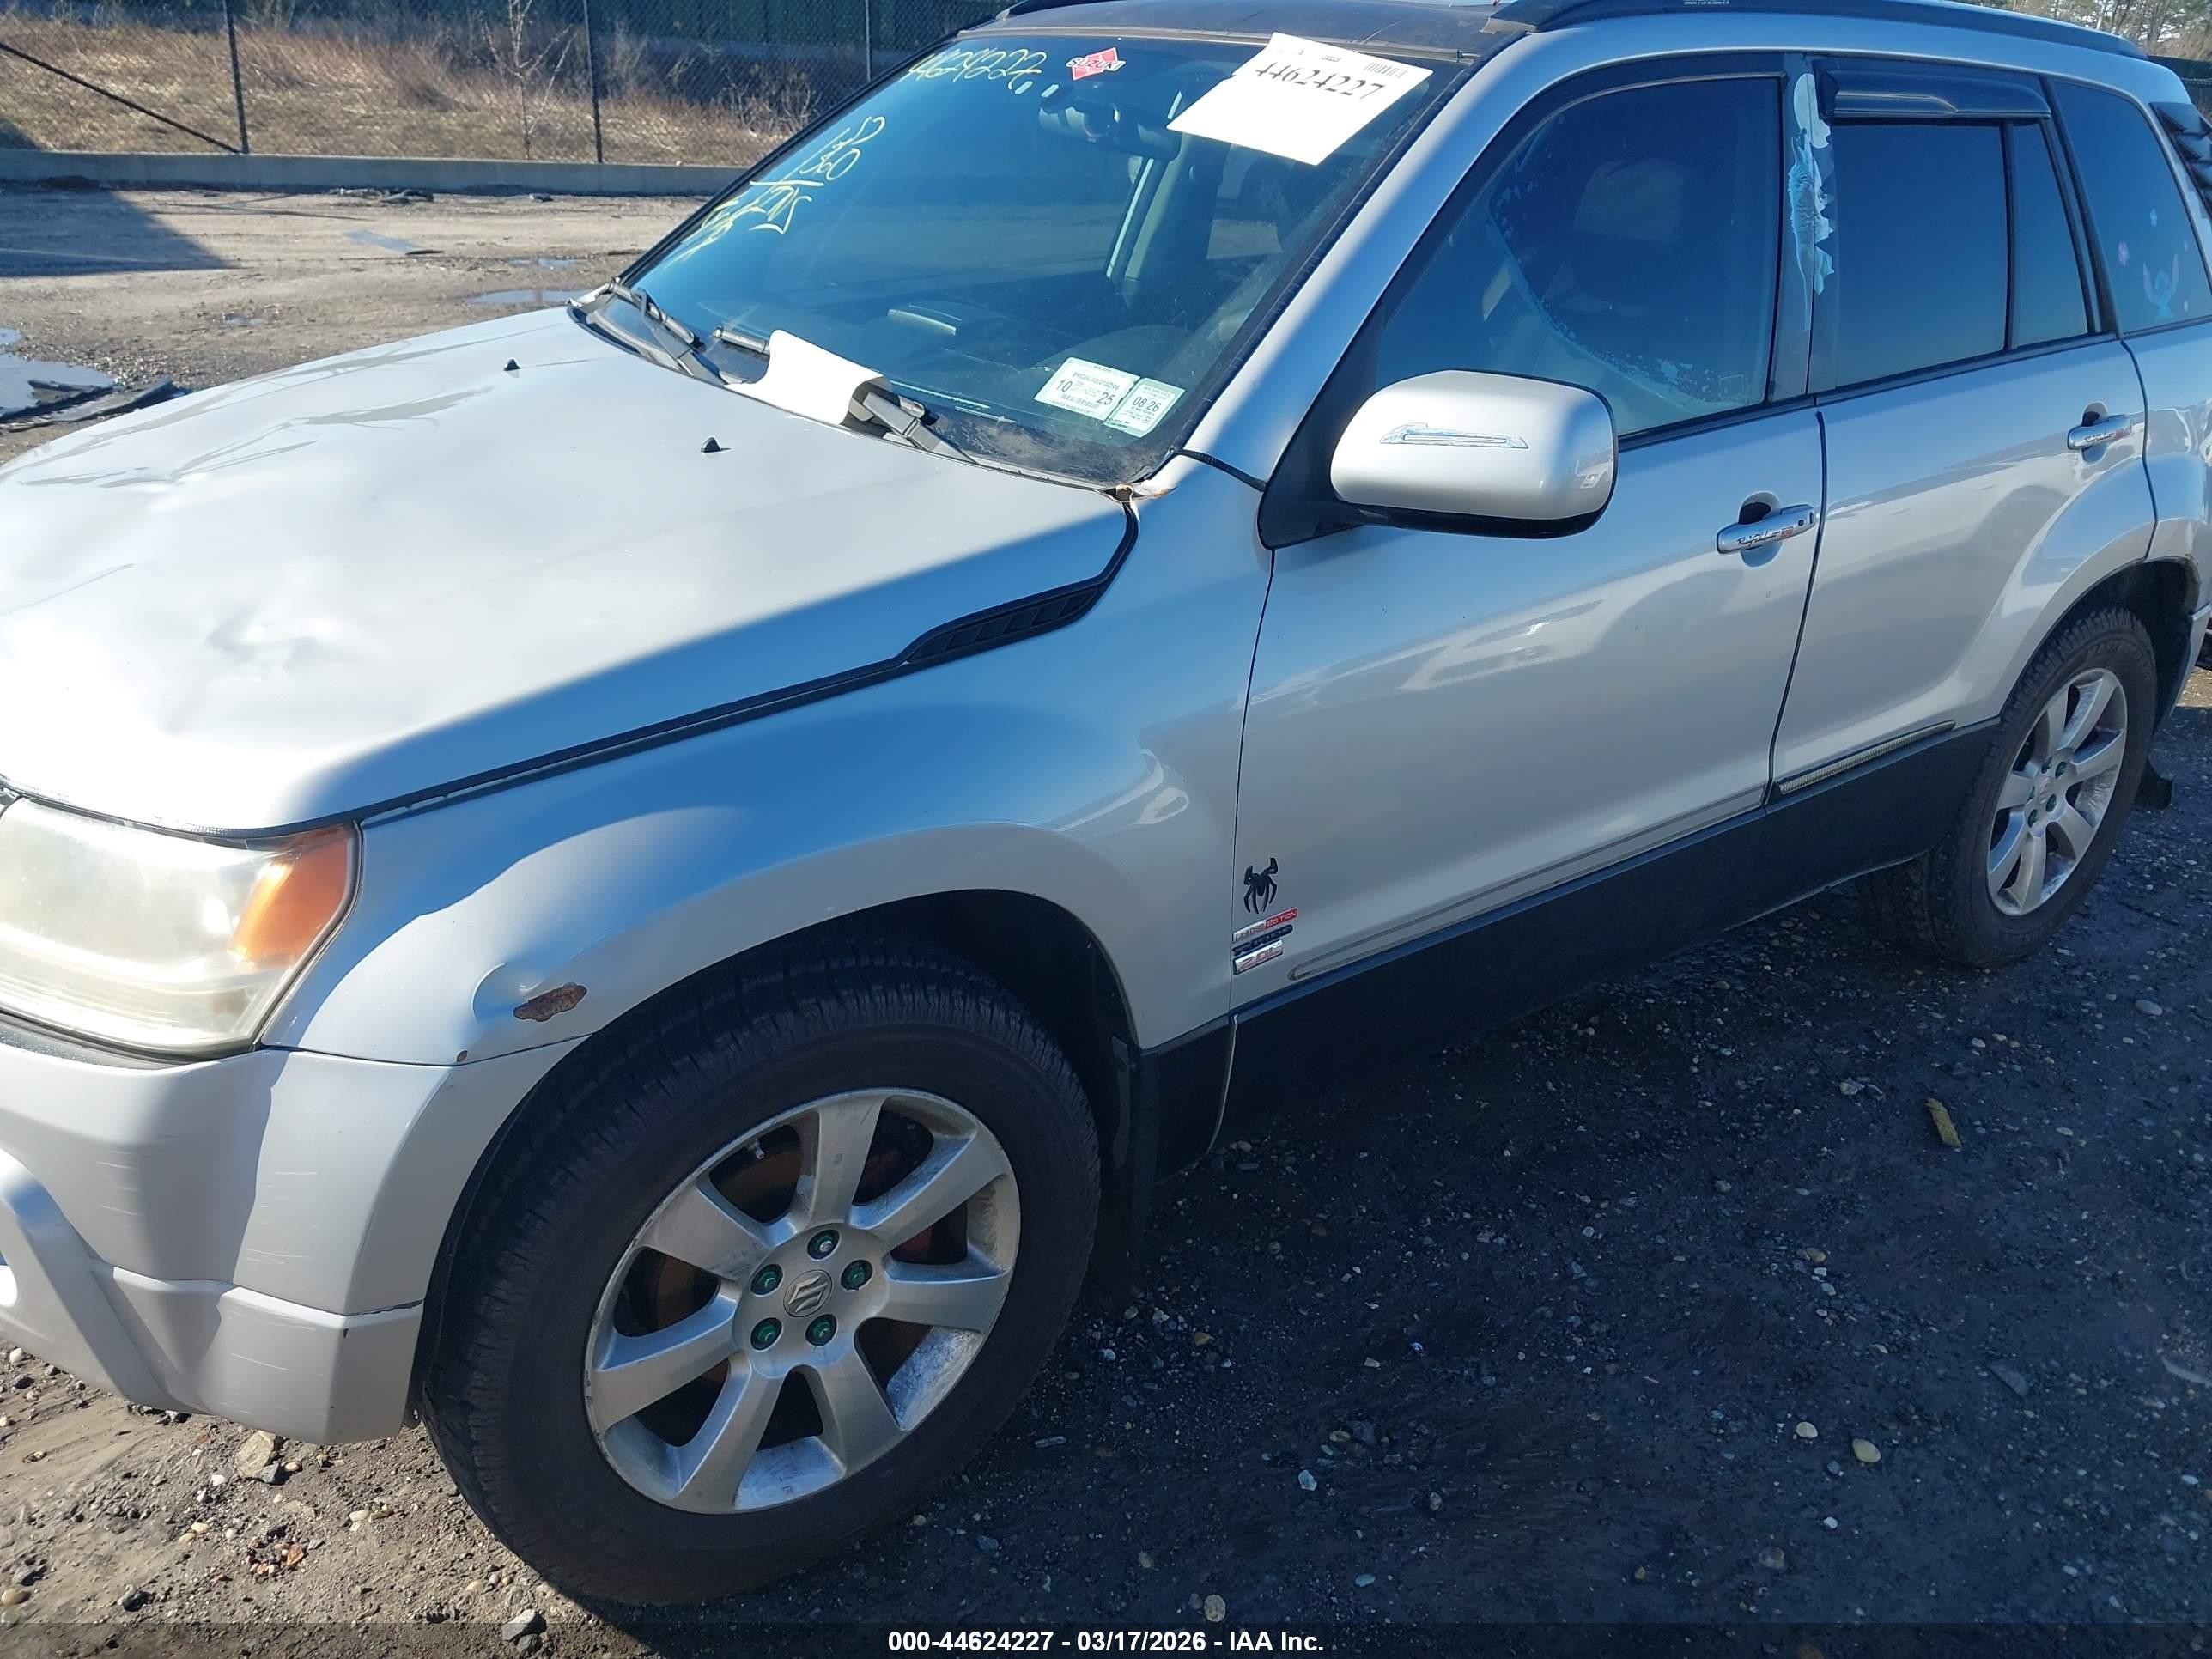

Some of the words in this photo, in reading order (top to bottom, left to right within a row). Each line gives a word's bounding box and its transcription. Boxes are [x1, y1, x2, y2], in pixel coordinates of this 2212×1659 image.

[1066, 56, 1126, 71] SUZUKI
[1255, 62, 1385, 100] 44624227
[1054, 379, 1074, 392] 10
[1096, 392, 1115, 406] 25
[1132, 396, 1162, 412] 08-26
[1267, 910, 1297, 926] EDITION
